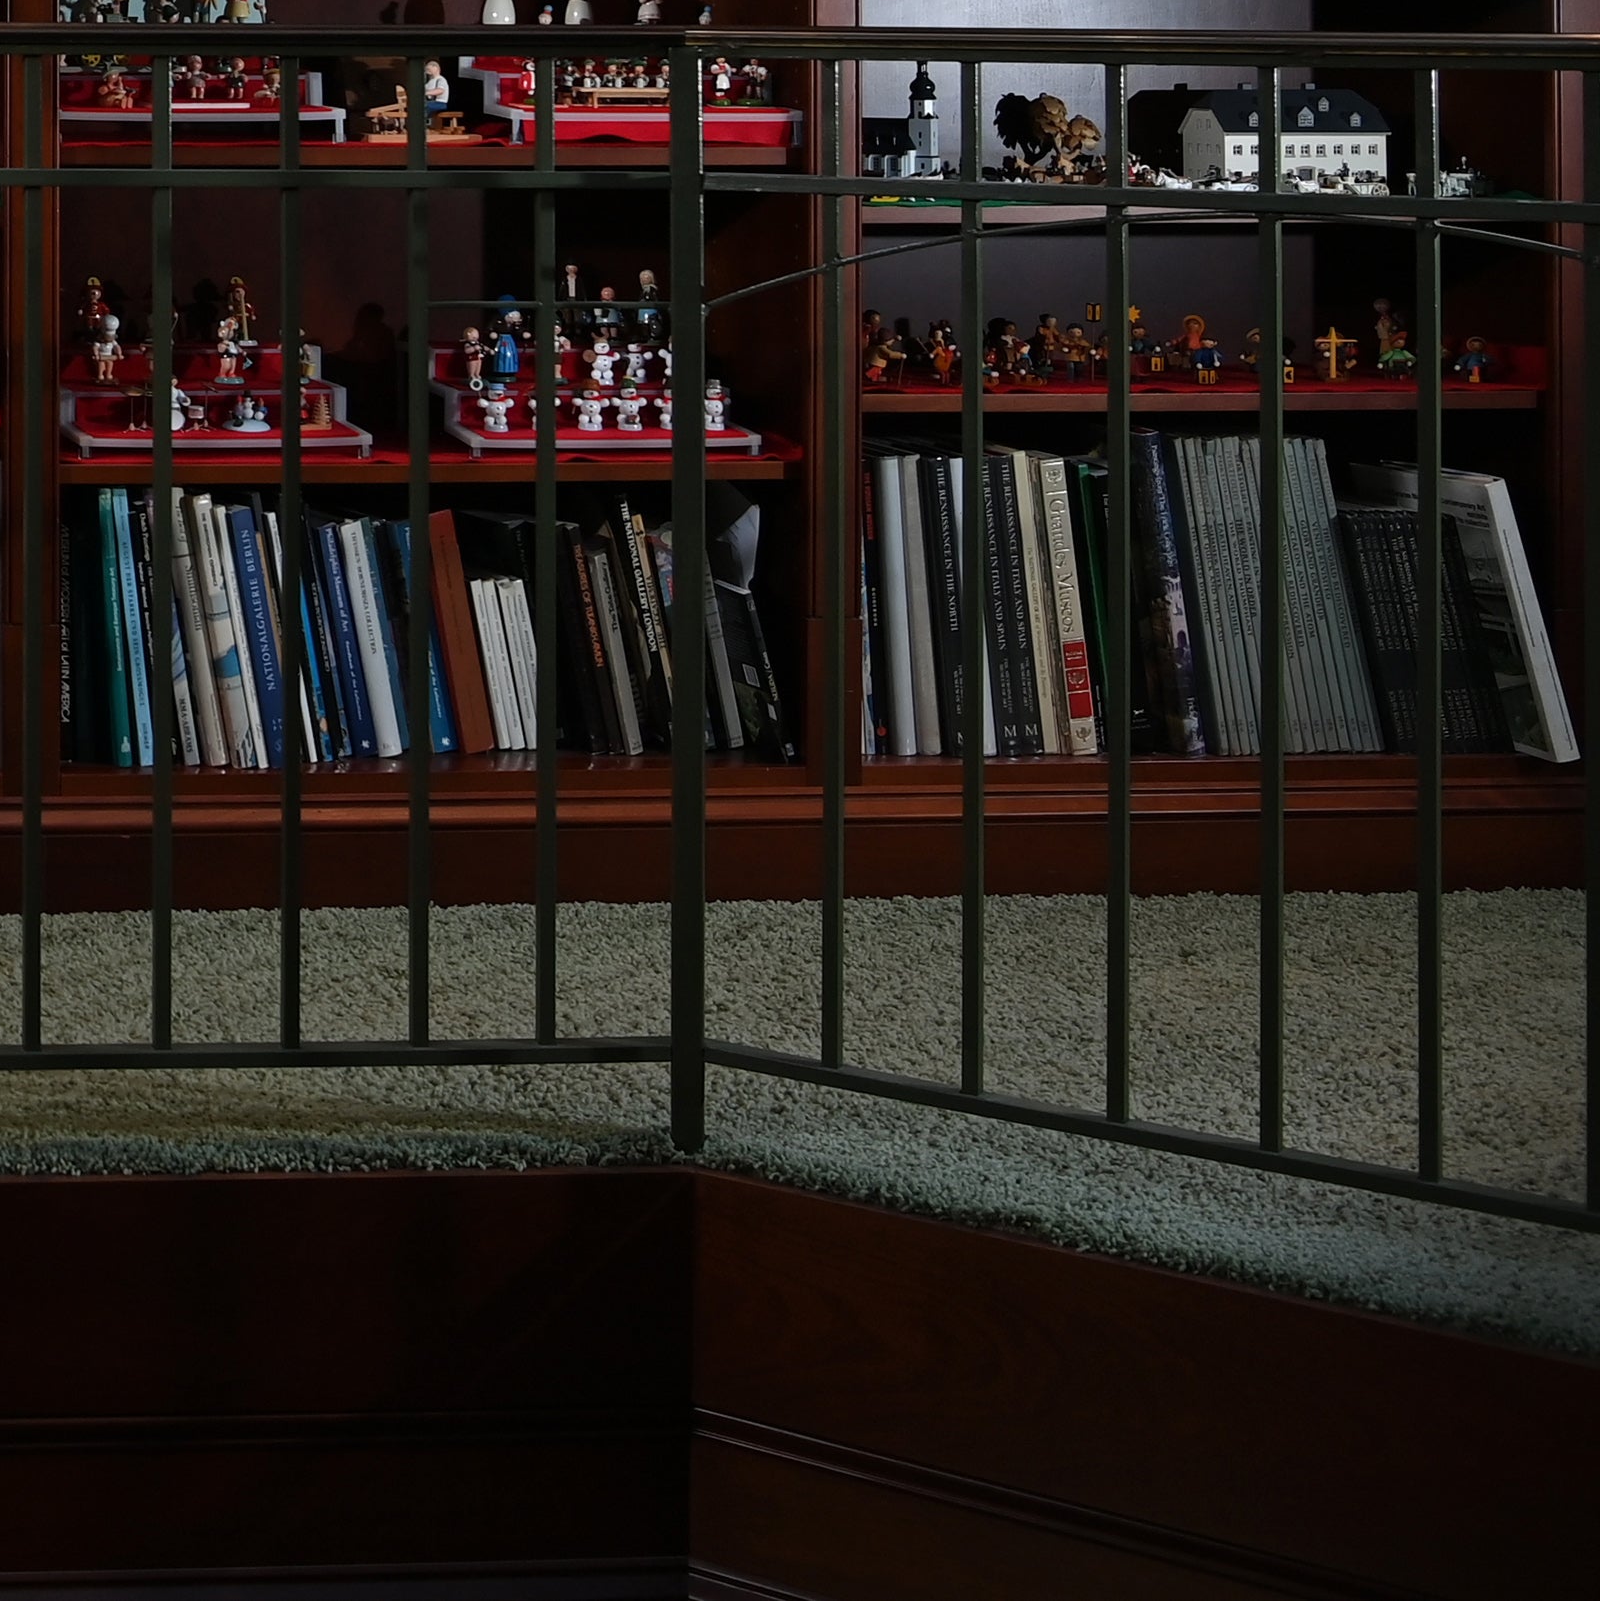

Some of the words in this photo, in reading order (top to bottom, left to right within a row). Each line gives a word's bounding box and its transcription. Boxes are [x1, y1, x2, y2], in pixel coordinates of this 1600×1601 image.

[936, 466, 945, 485] THE
[1001, 463, 1010, 484] THE
[619, 501, 629, 519] THE
[937, 486, 951, 557] RENAISSANCE
[1002, 485, 1017, 553] RENAISSANCE
[626, 520, 639, 569] NATIONAL
[1048, 498, 1071, 569] Grandes
[240, 530, 255, 572] BERLIN
[944, 558, 953, 569] IN
[990, 555, 999, 566] IN
[1010, 554, 1019, 565] IN
[632, 569, 646, 609] GALLERY
[945, 573, 955, 594] THE
[991, 569, 1001, 596] ITALY
[1011, 568, 1021, 596] ITALY
[947, 595, 959, 632] NORTH
[994, 600, 1004, 620] AND
[1014, 597, 1024, 619] AND
[1056, 572, 1074, 633] Museos
[248, 581, 276, 690] NATIONALGALERIE
[644, 612, 657, 652] LONDON
[996, 621, 1006, 650] SPAIN
[1017, 621, 1027, 649] SPAIN
